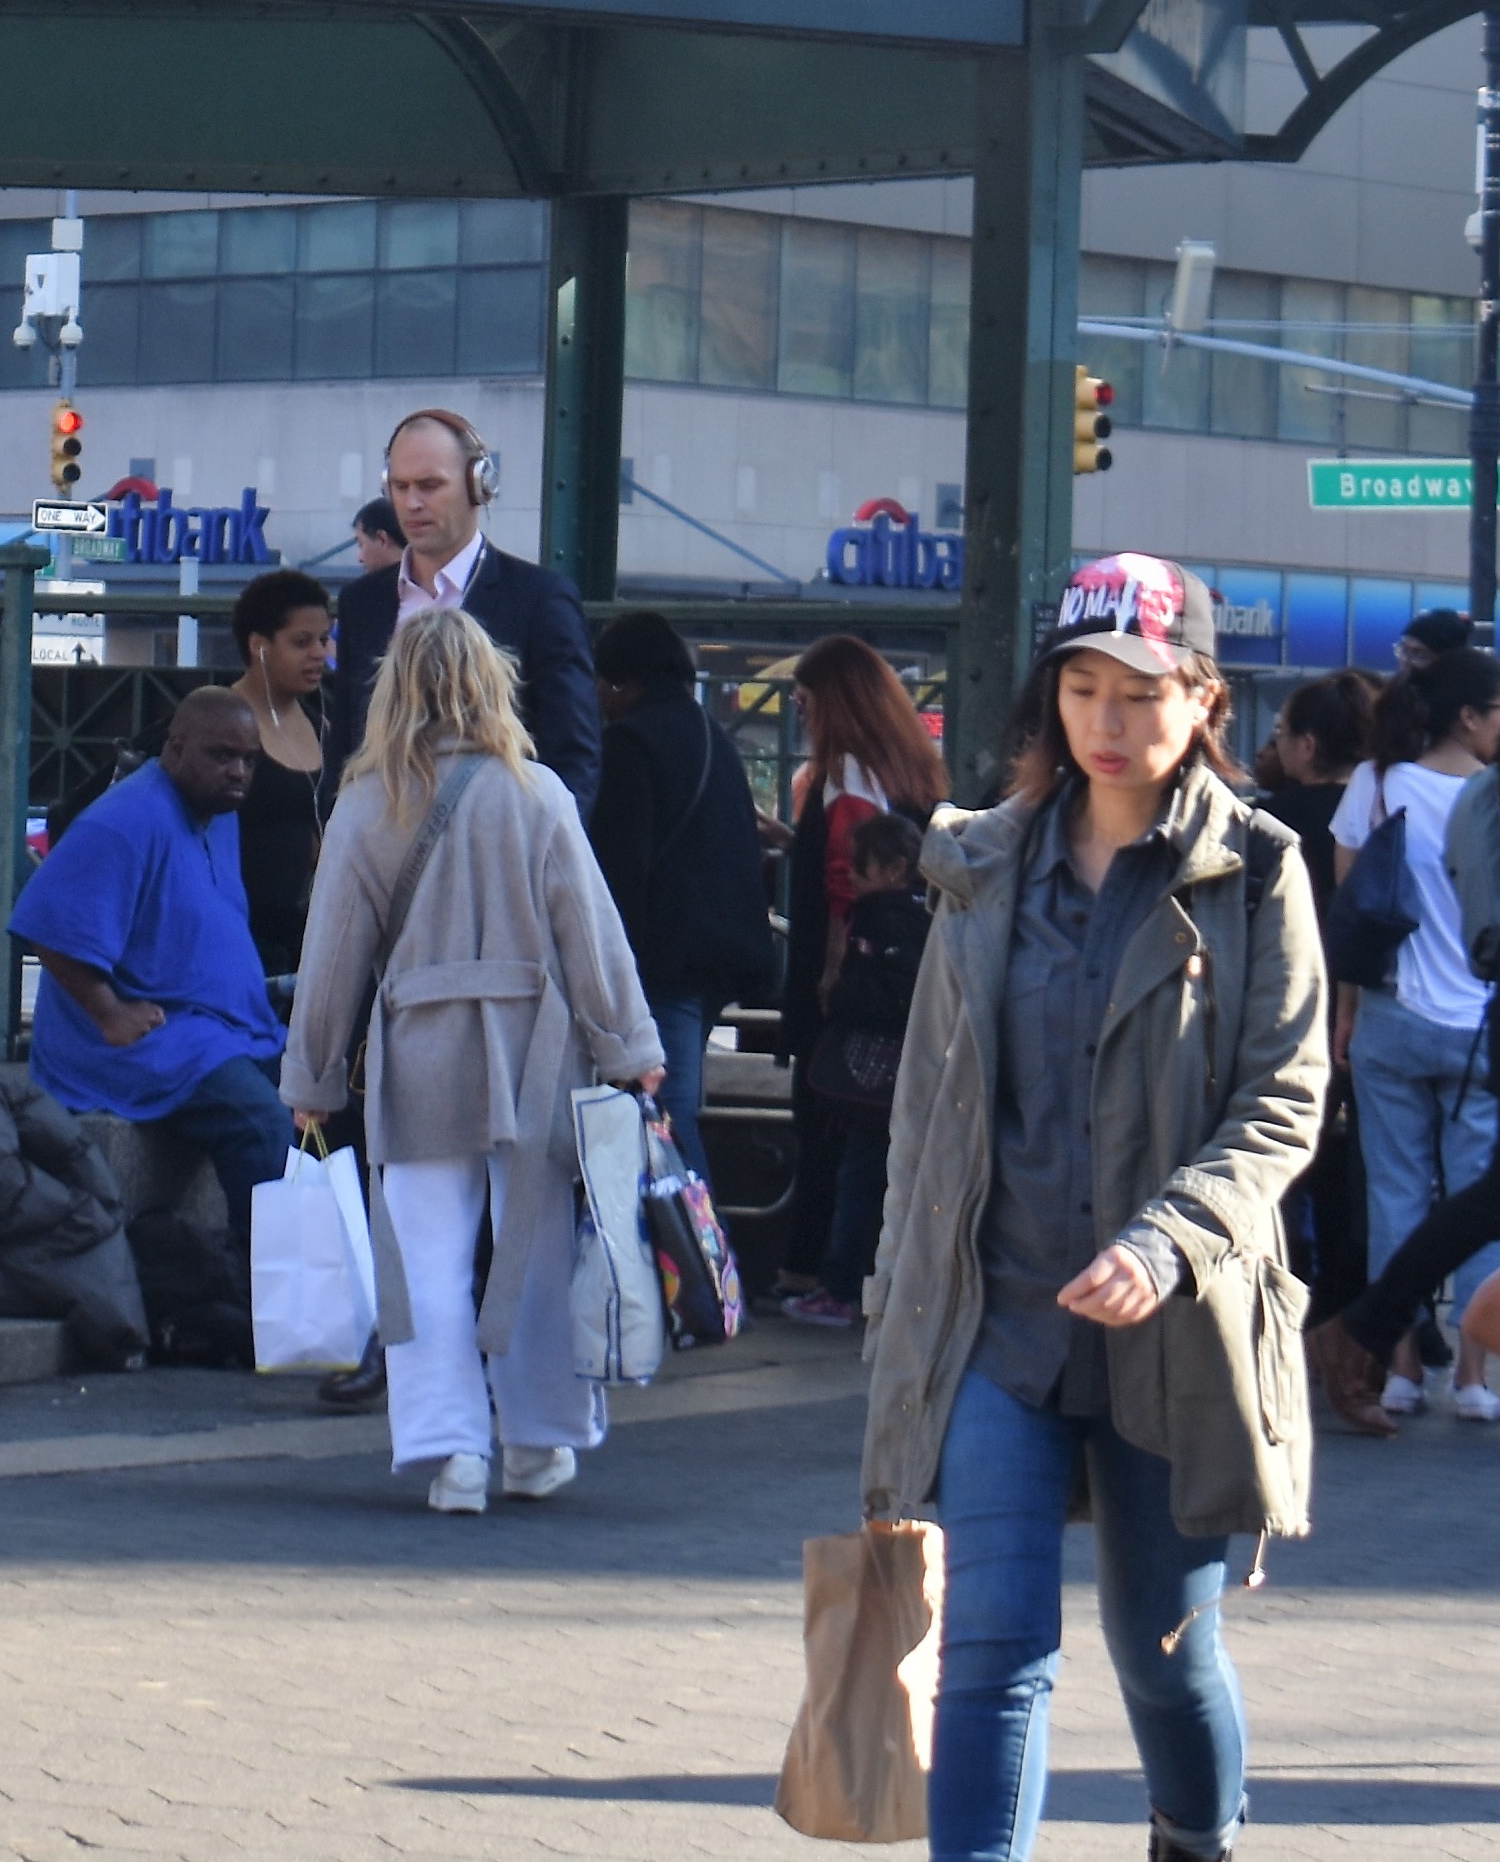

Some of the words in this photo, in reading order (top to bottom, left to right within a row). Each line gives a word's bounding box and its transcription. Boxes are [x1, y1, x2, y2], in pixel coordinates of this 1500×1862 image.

[40, 509, 62, 522] ONE
[74, 511, 97, 524] WAY
[32, 648, 68, 661] LOCAL
